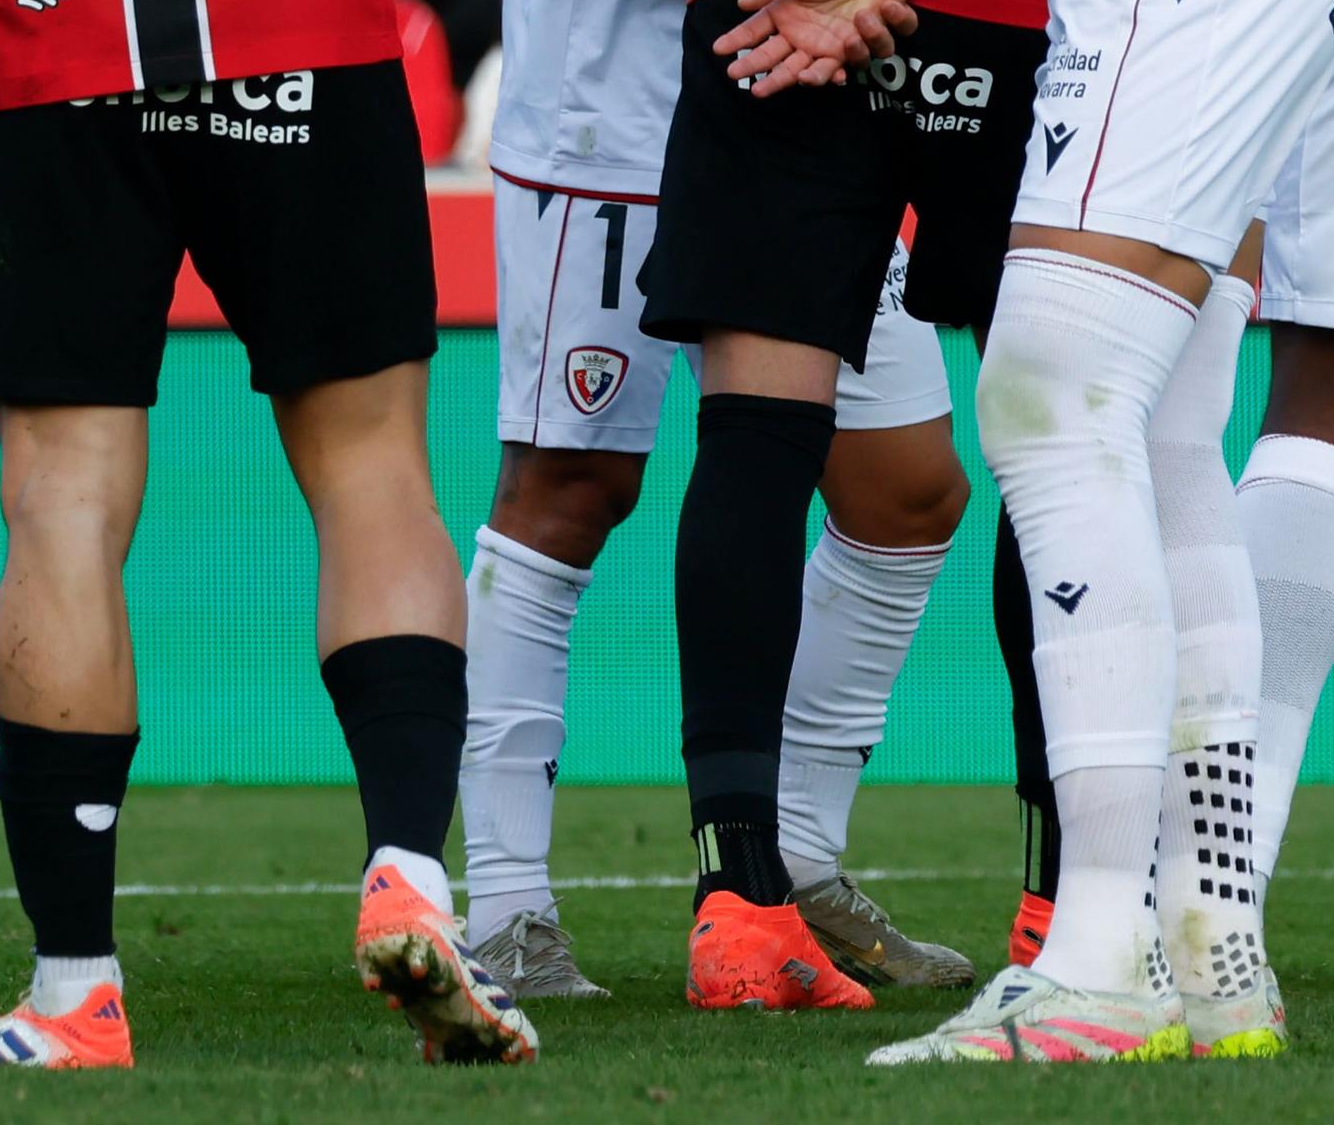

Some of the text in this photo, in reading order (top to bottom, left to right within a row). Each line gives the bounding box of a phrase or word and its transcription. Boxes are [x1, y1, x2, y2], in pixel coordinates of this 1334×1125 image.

[141, 110, 311, 145] Illes Balears
[914, 111, 982, 134] alears
